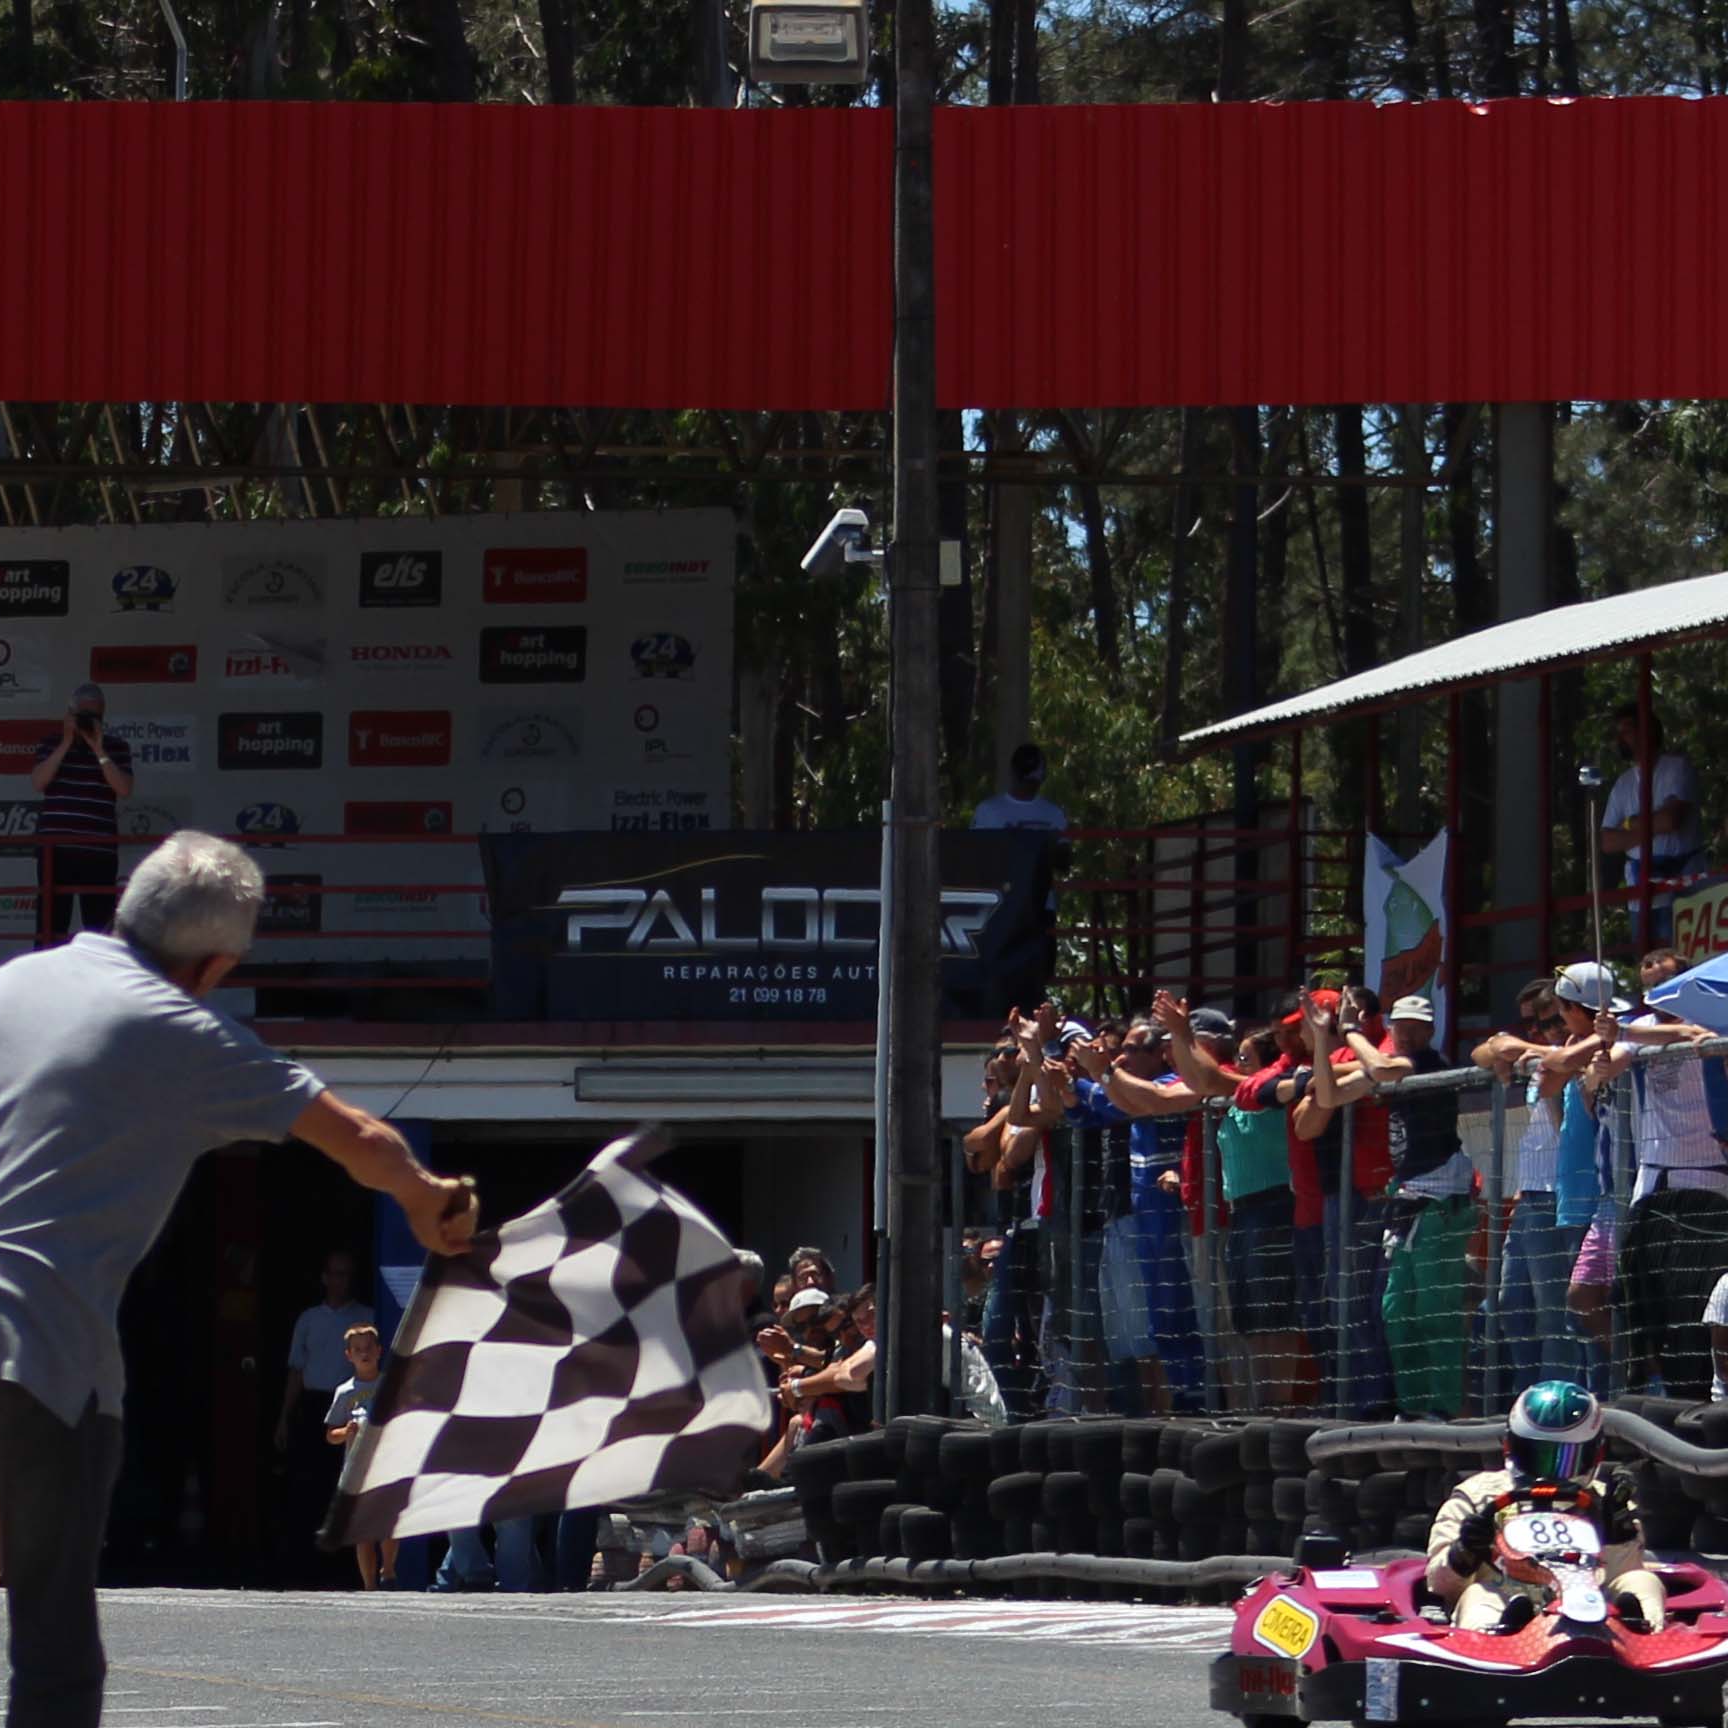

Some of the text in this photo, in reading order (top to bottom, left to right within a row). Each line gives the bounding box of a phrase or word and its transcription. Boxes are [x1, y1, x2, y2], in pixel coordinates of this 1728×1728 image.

[351, 644, 453, 661] HONDA
[663, 963, 877, 982] REPARAÇÕES AUT
[1529, 1519, 1573, 1545] 88
[1262, 1607, 1310, 1648] CIMEIRA
